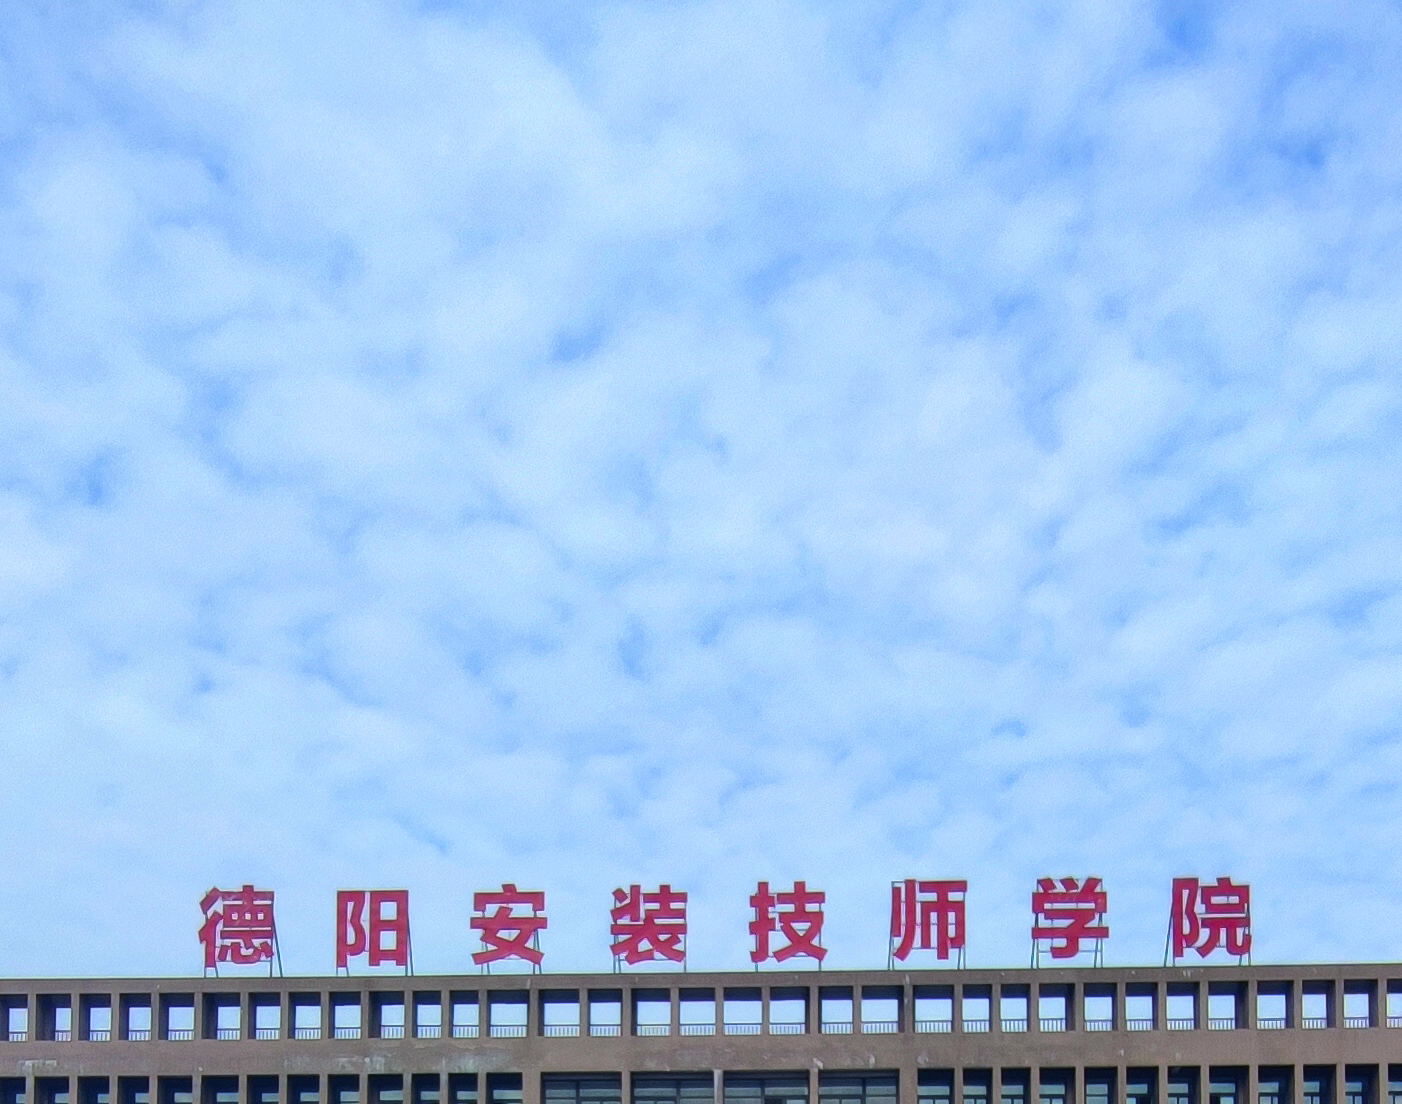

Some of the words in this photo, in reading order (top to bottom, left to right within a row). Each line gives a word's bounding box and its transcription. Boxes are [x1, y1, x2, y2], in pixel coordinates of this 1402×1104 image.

[199, 877, 1252, 967] 德阳安装技师学院
